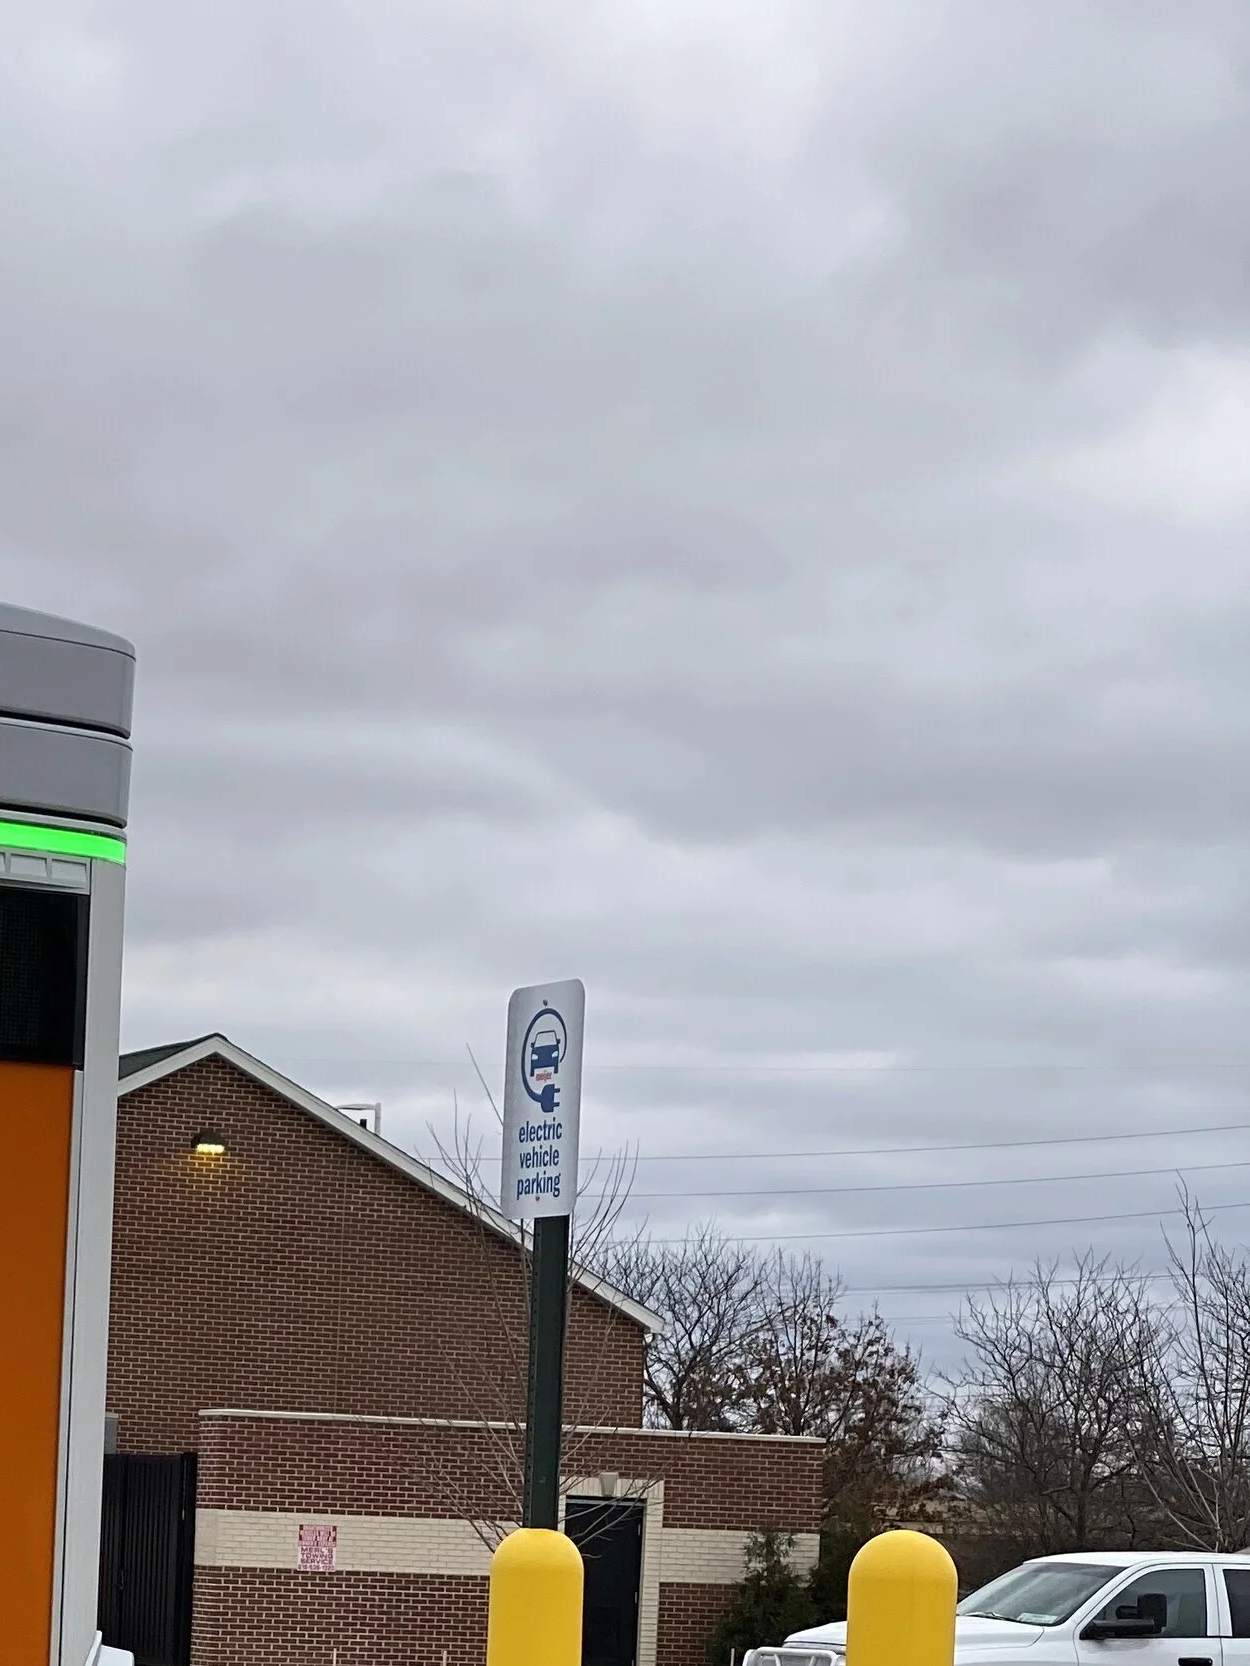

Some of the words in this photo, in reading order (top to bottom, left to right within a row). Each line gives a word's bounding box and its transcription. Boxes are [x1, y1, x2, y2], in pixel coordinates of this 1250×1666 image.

[518, 1116, 563, 1143] electric
[519, 1145, 560, 1169] vehicle
[517, 1170, 561, 1200] parking
